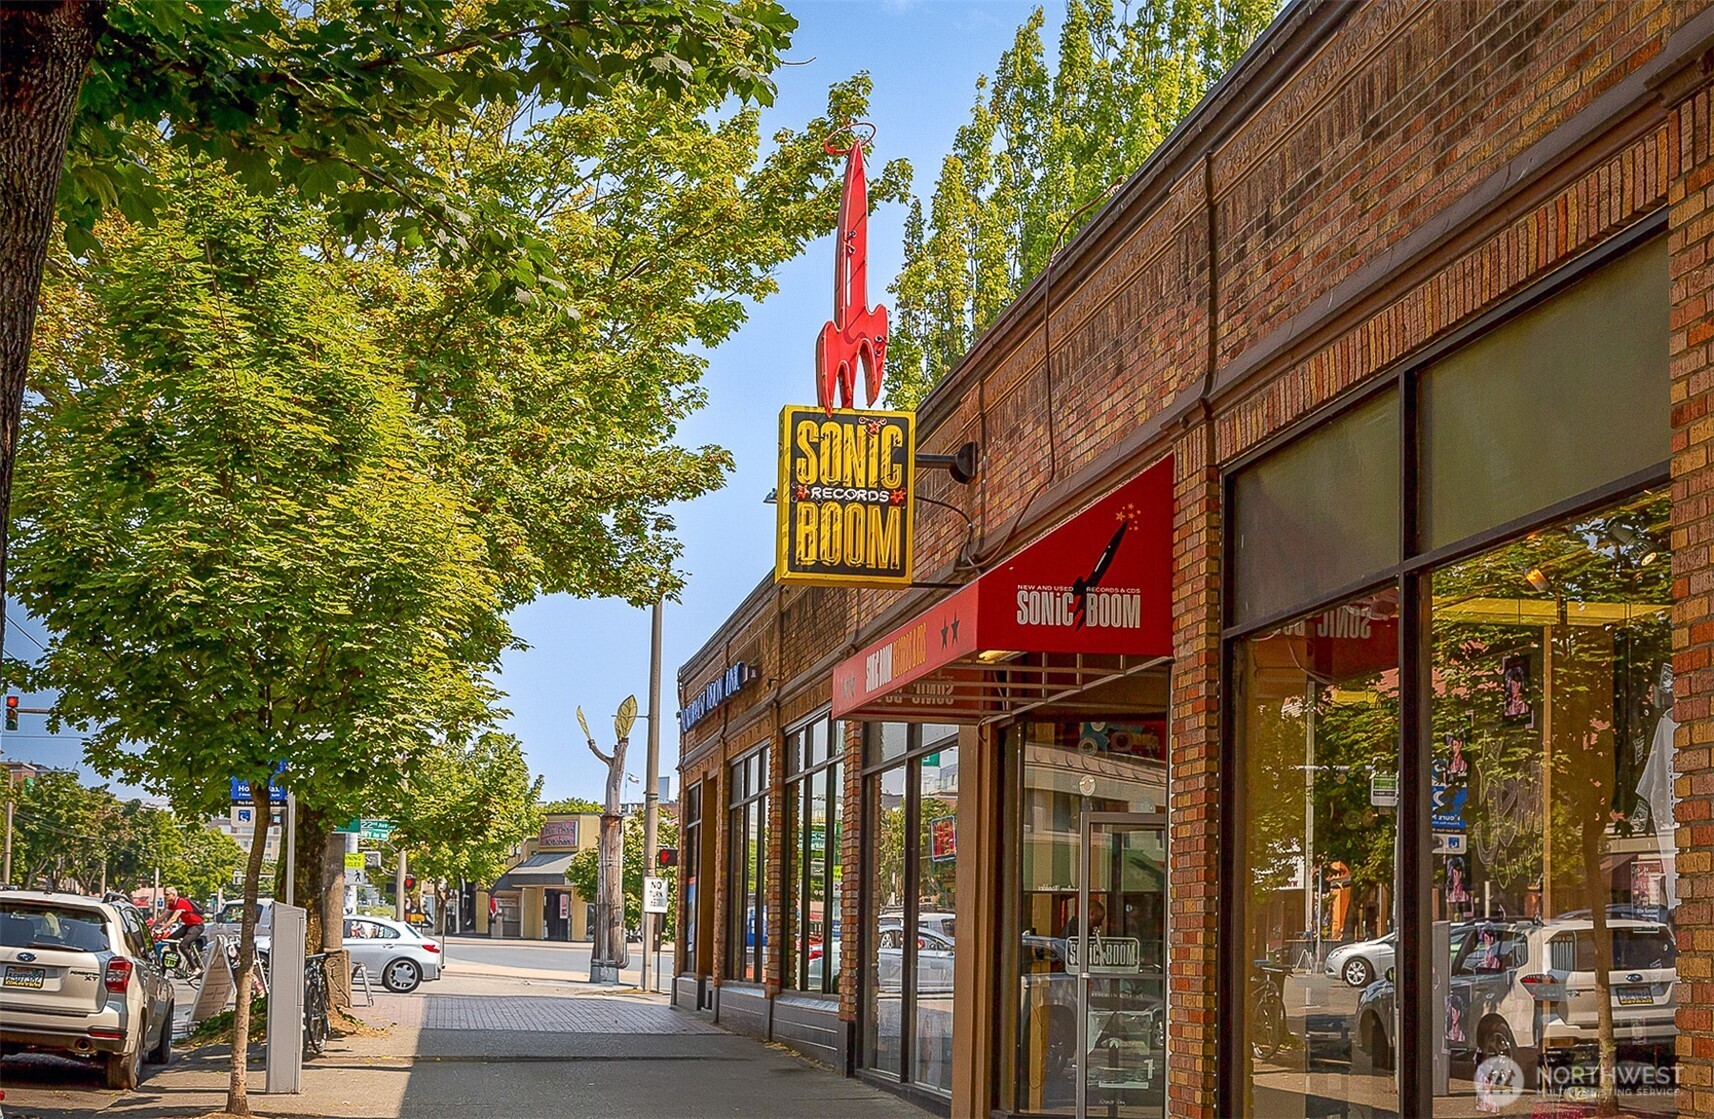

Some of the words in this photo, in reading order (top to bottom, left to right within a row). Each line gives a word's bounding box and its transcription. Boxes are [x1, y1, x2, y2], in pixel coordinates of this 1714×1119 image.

[810, 486, 890, 503] RECORDS
[795, 502, 901, 570] BOOM
[1086, 592, 1141, 629] BOOM
[650, 881, 663, 890] NO
[1106, 944, 1136, 966] BOOM
